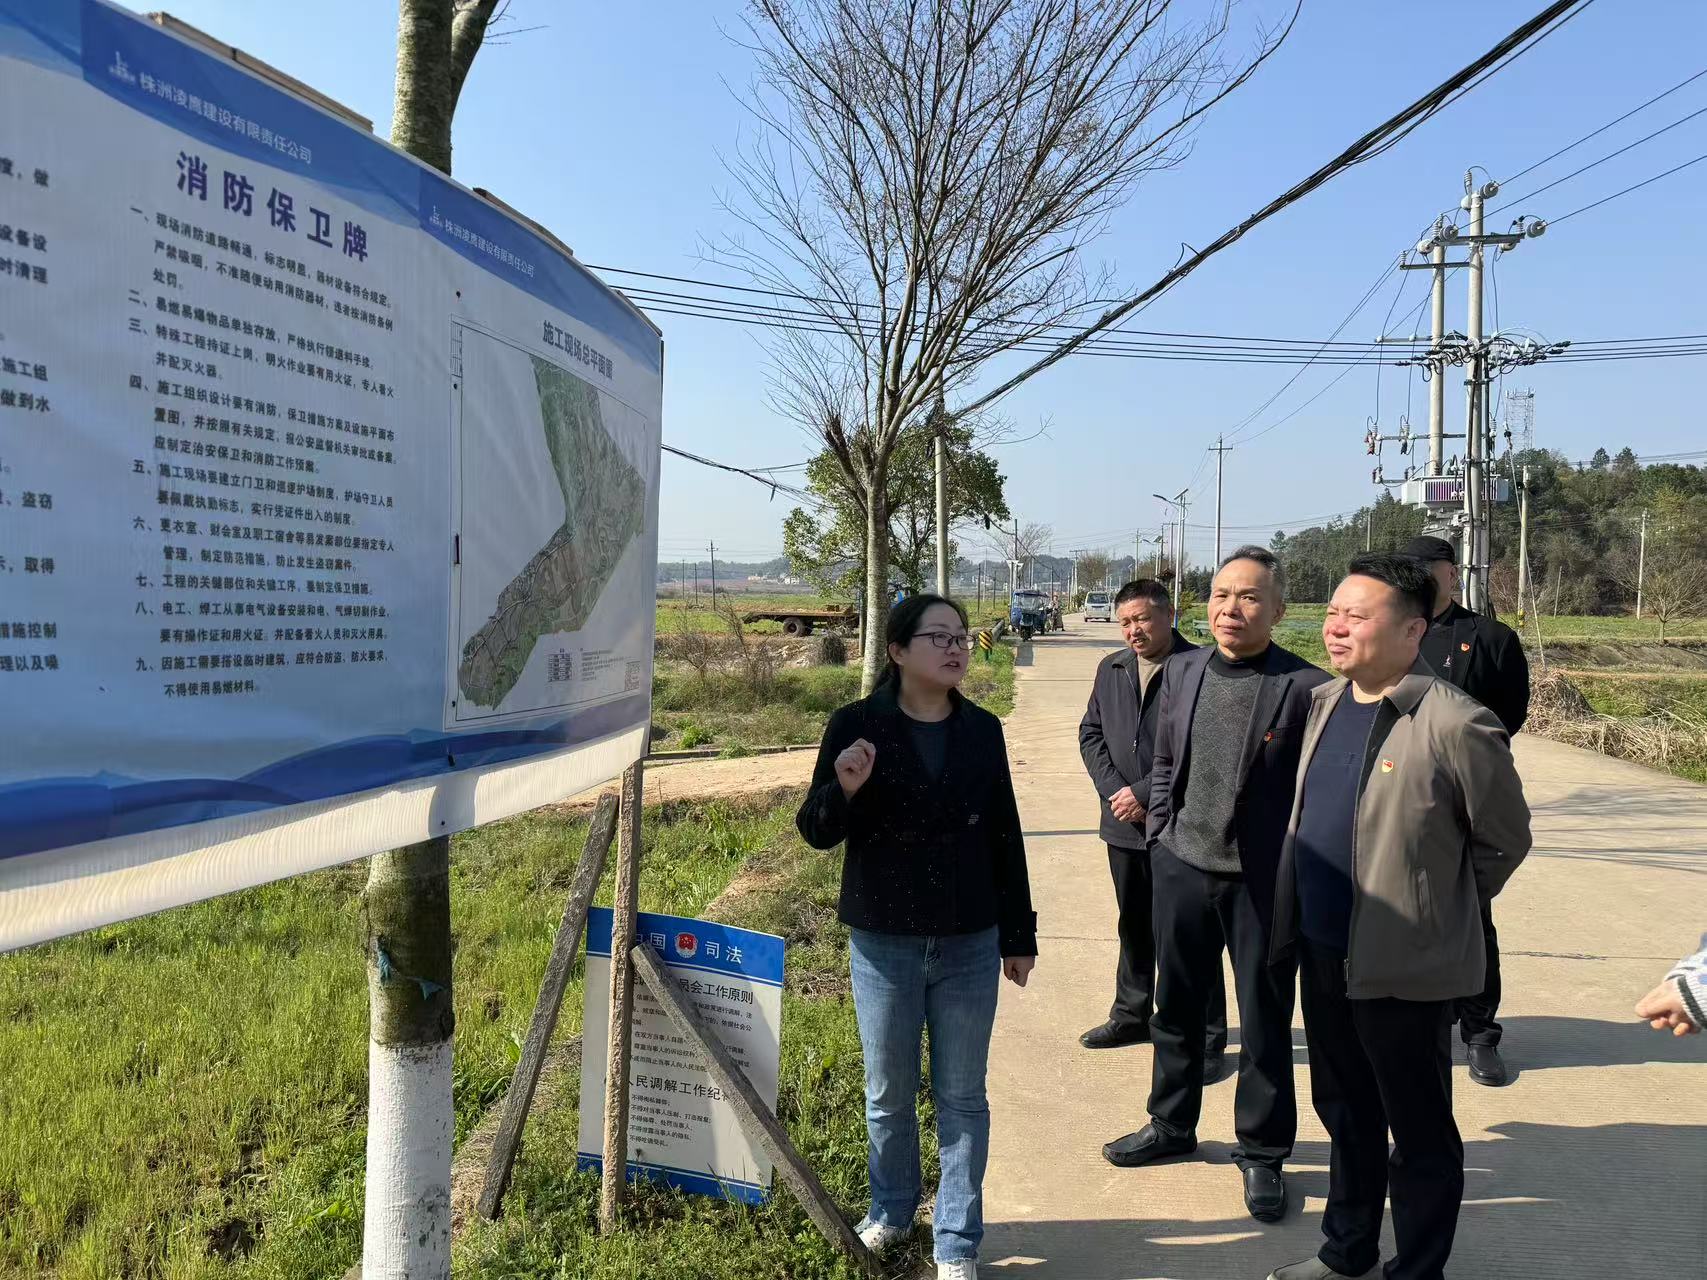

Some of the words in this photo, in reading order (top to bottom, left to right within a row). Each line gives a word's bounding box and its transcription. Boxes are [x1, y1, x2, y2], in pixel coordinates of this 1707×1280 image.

[176, 151, 368, 263] 消防保卫牌
[543, 319, 614, 380] 施工现场总平面图
[0, 355, 49, 382] 施工组
[0, 489, 53, 510] 、盗窃
[704, 940, 743, 964] 司法
[629, 1074, 729, 1102] 民调解工作纪
